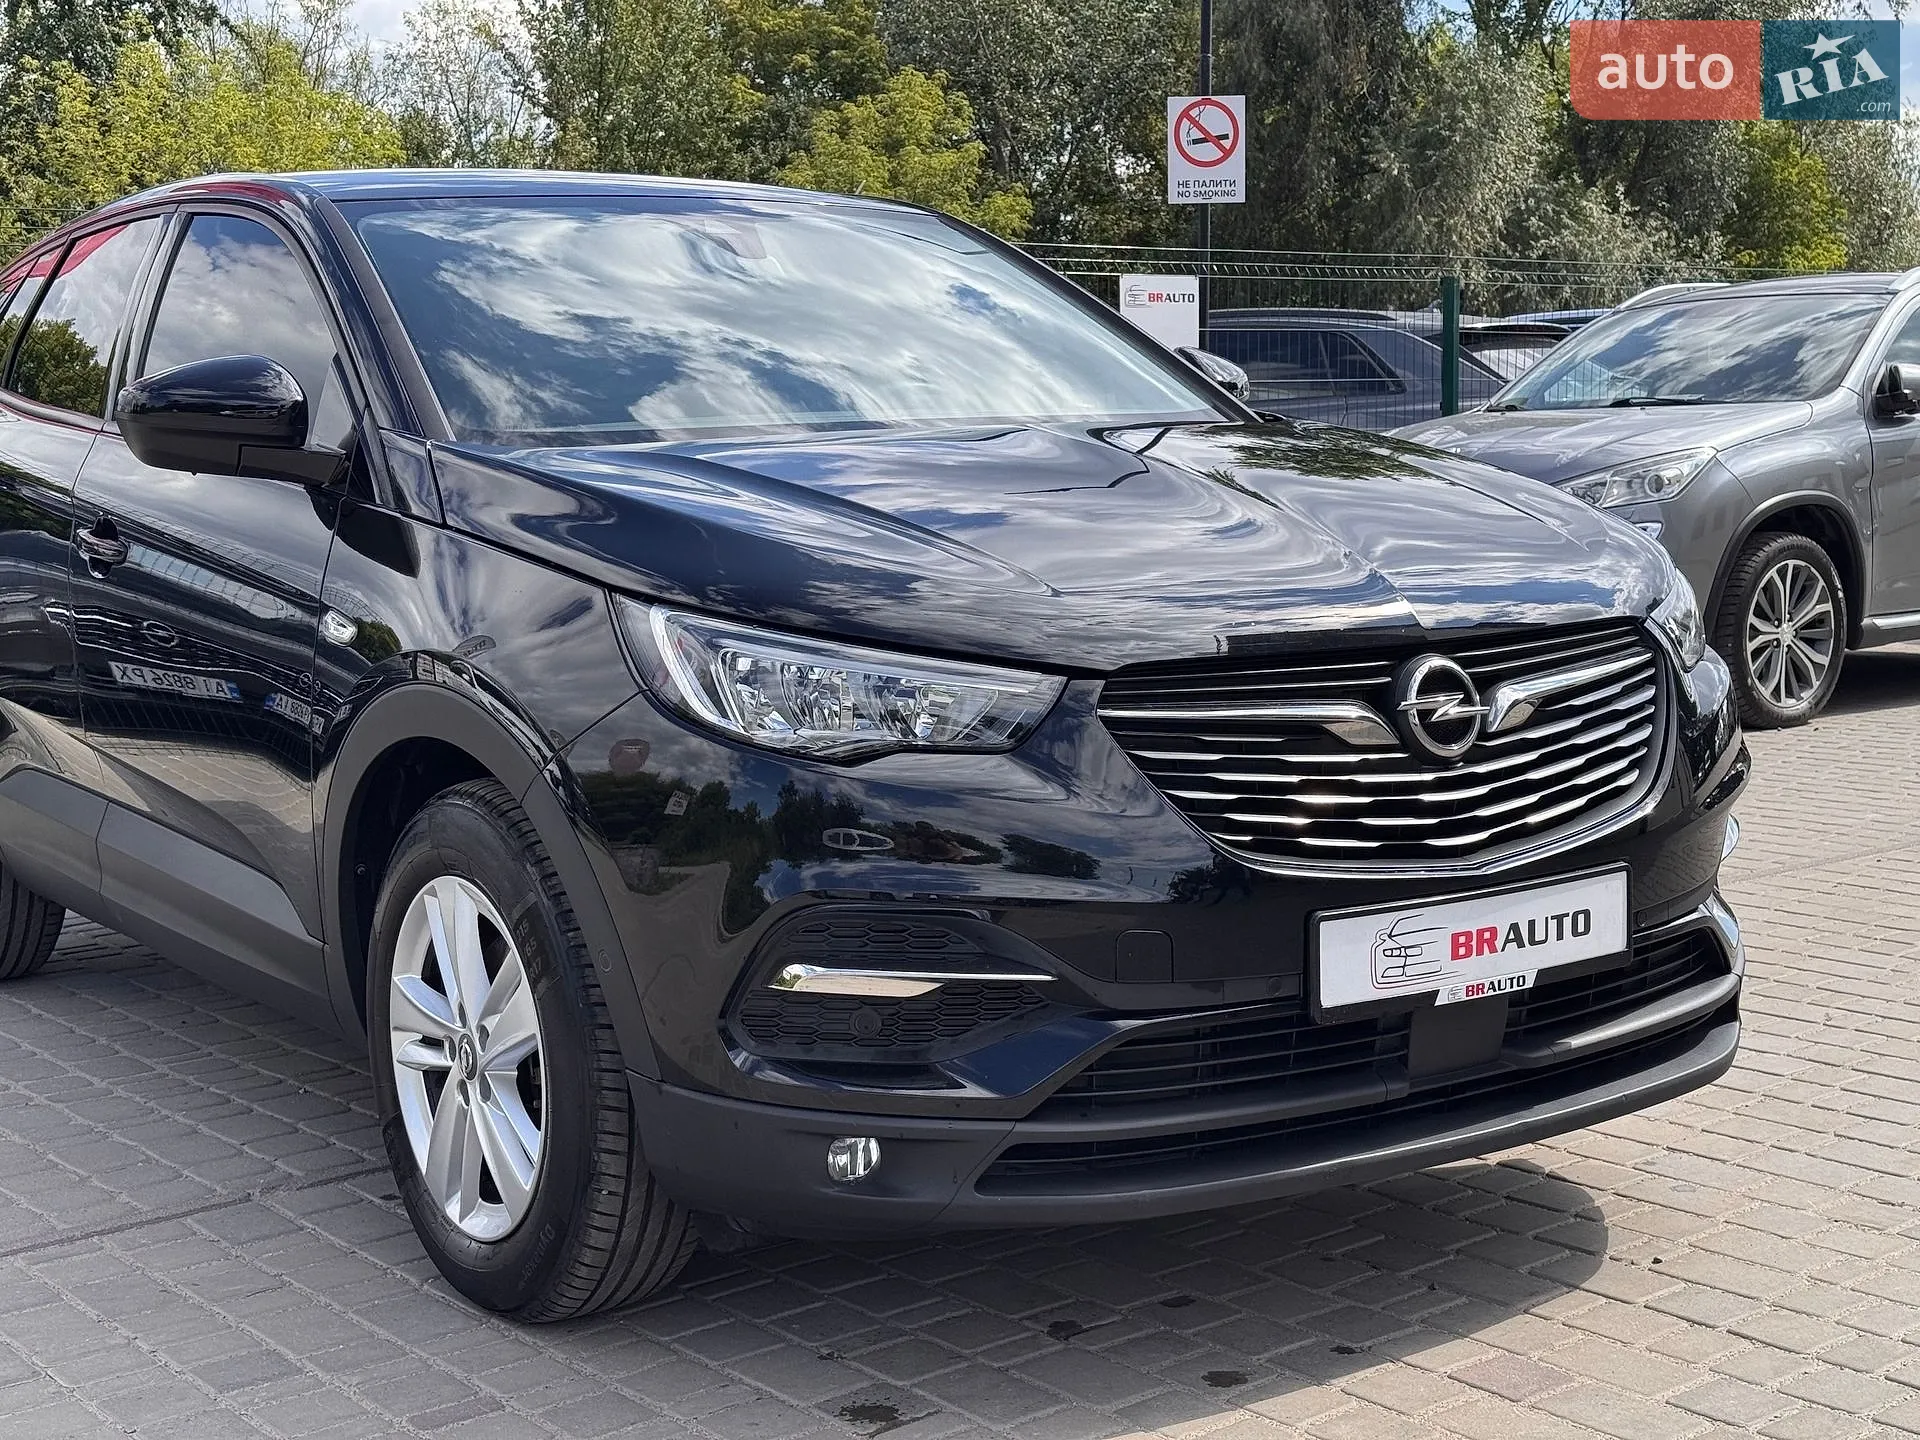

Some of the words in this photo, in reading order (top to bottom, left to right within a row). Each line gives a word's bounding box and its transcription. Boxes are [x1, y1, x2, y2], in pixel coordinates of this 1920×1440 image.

[1177, 180, 1191, 189] НЕ
[1193, 179, 1237, 189] ПАЛИТИ
[1177, 190, 1191, 198] NO
[1193, 189, 1237, 198] SMOKING
[1147, 292, 1195, 304] BRAUTO
[1450, 908, 1592, 961] BRAUTO
[1465, 974, 1527, 997] BRAUTO
